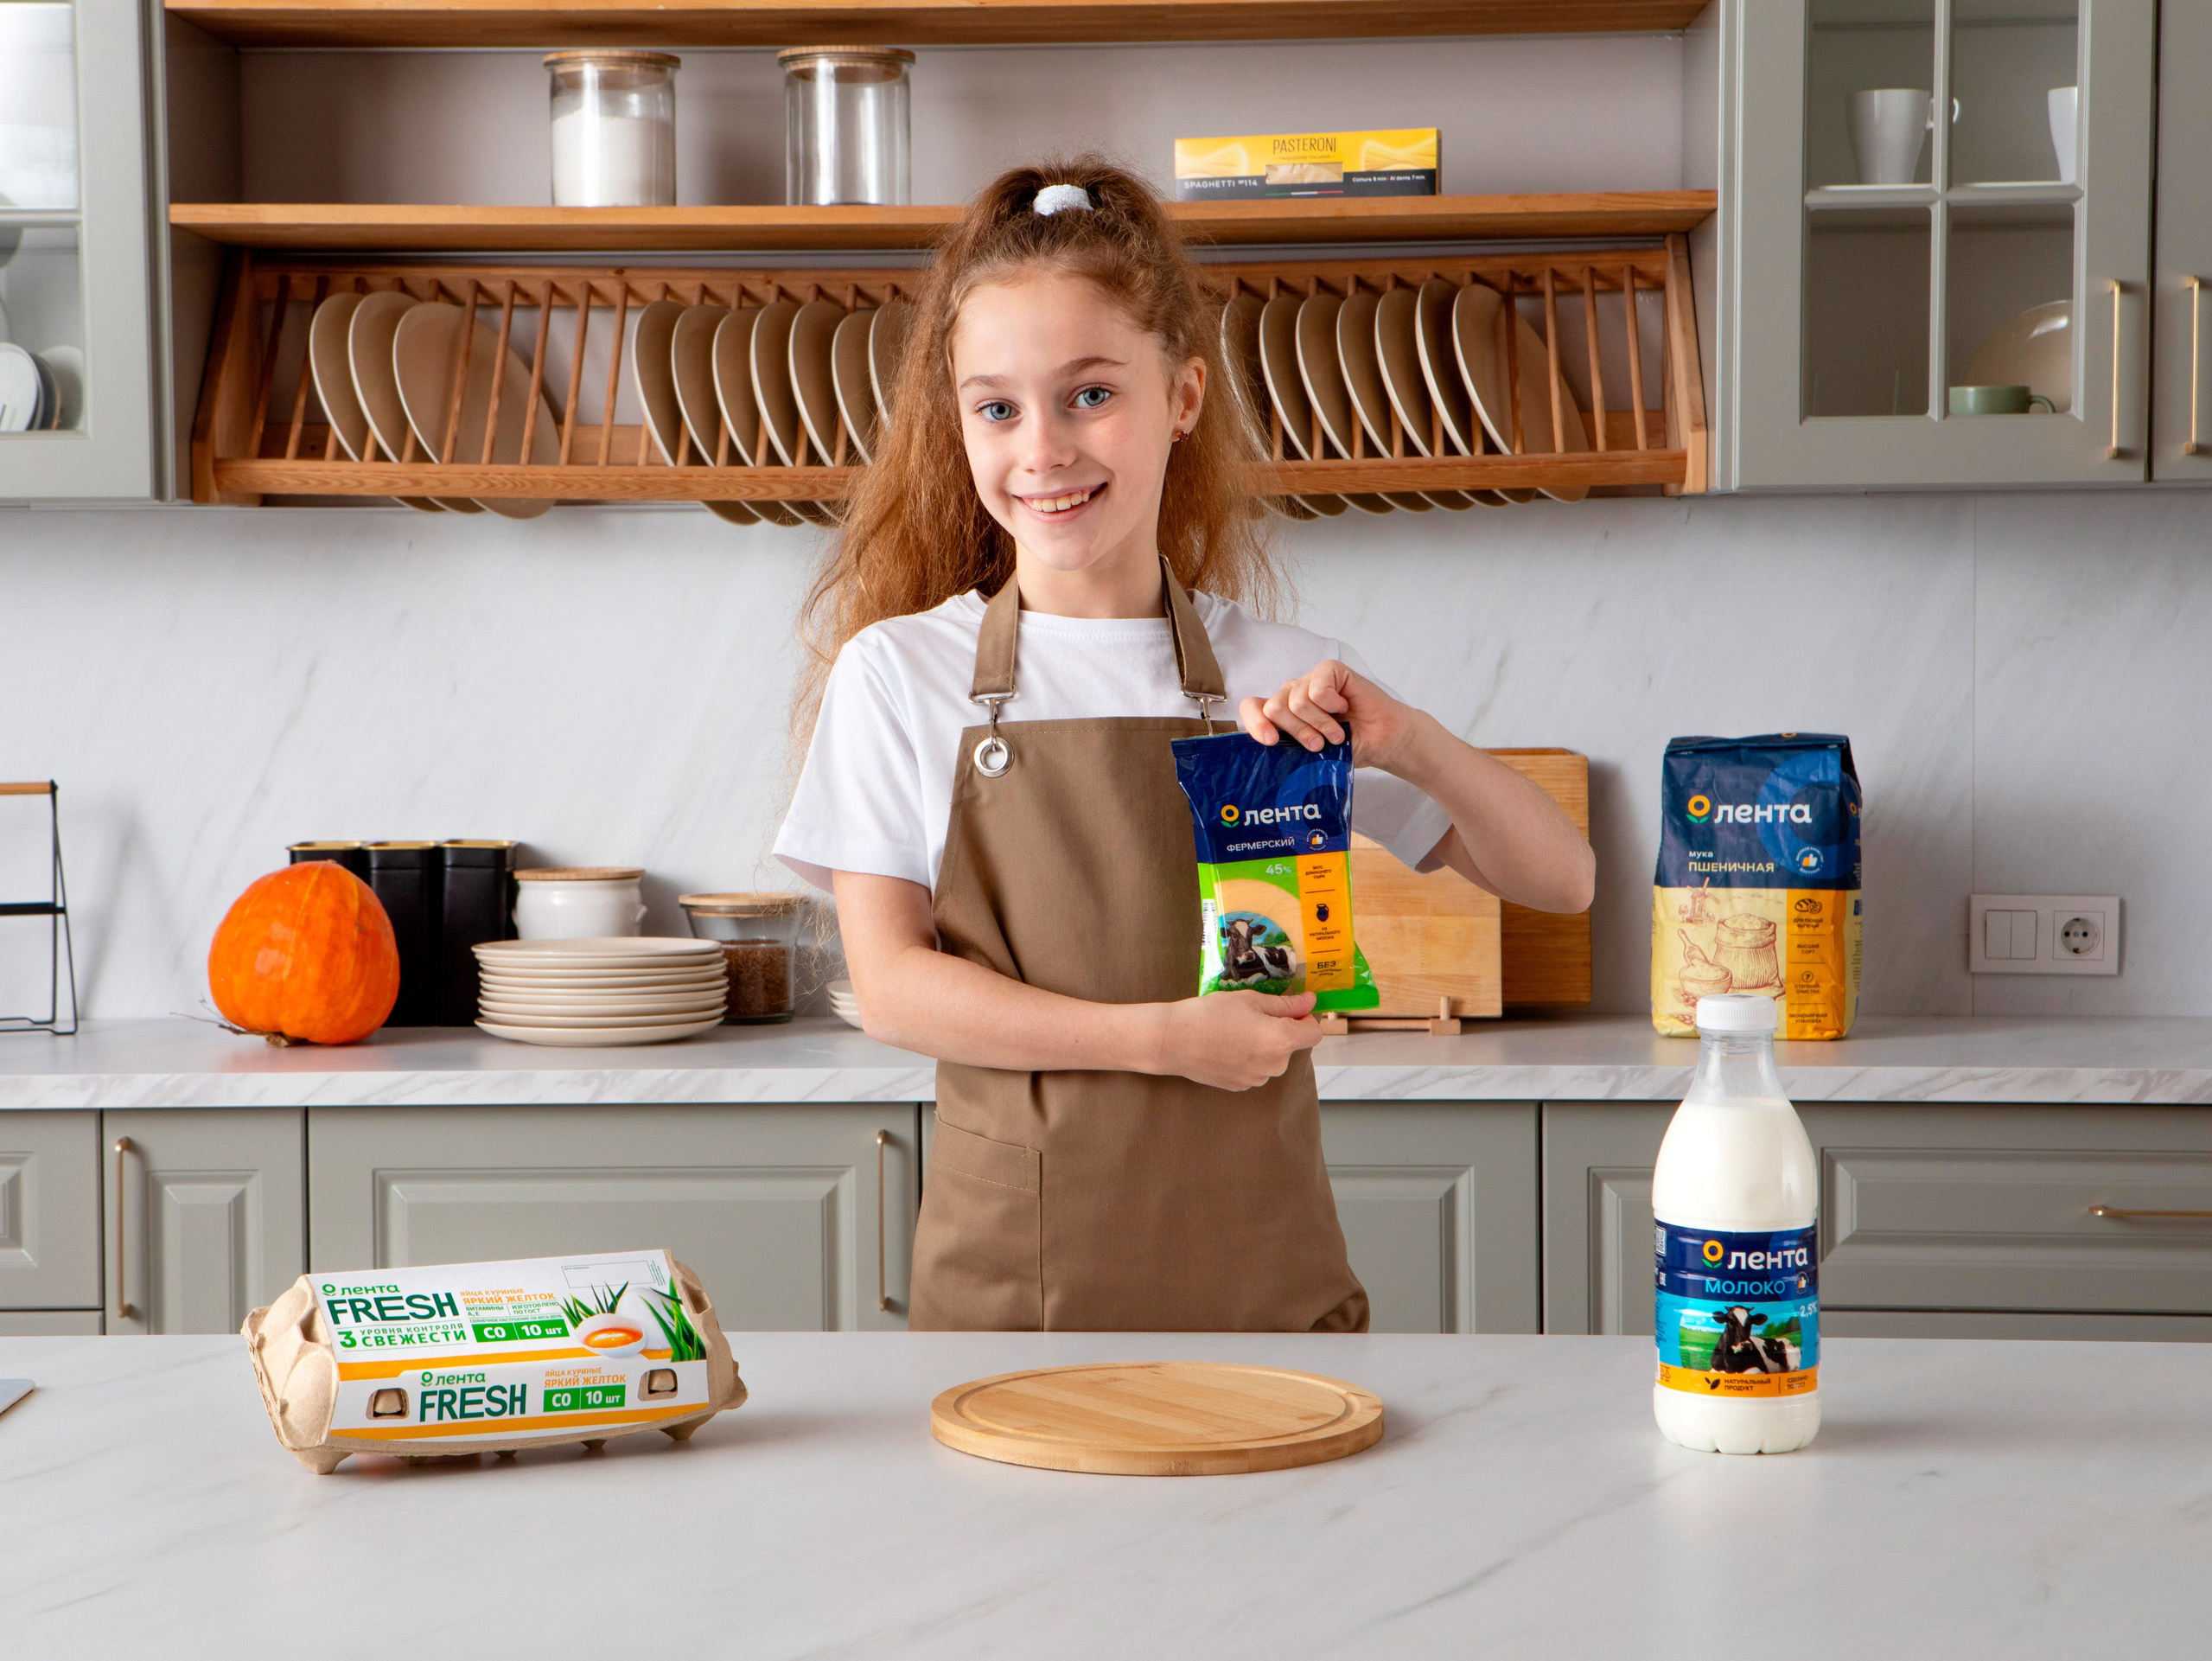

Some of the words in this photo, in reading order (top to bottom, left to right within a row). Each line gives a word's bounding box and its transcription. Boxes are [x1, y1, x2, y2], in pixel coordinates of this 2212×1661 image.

[1273, 137, 1336, 155] PASTERONI
[1184, 180, 1235, 189] SPAGHETTI
[1244, 803, 1322, 827] лента
[1714, 803, 1813, 824] лента
[1227, 836, 1295, 852] ФЕРМЕРСКИЙ
[1265, 864, 1291, 875] 45%
[1688, 861, 1775, 872] ПШЕНИЧНАЯ
[1316, 961, 1336, 969] БЕЗ
[1727, 1248, 1808, 1270] лента
[341, 1284, 401, 1296] лента
[462, 1295, 503, 1305] ЯРКИЙ
[506, 1293, 556, 1303] ЖЕЛТОК
[327, 1292, 460, 1325] FRESH
[360, 1327, 403, 1336] УРОВНЯ
[407, 1323, 464, 1333] КОНТРОЛЯ
[520, 1325, 542, 1337] 10
[545, 1327, 563, 1336] шт
[337, 1330, 358, 1349] 3
[361, 1330, 467, 1347] СВЕЖЕСТИ
[435, 1372, 486, 1386] лента
[545, 1369, 566, 1378] ЯЙЦА
[567, 1367, 602, 1377] КУРИНЫЕ
[545, 1376, 580, 1389] ЯРКИЙ
[582, 1374, 627, 1386] ЖЕЛТОК
[419, 1383, 527, 1422] FRESH
[585, 1390, 603, 1405] 10
[606, 1395, 621, 1403] шт
